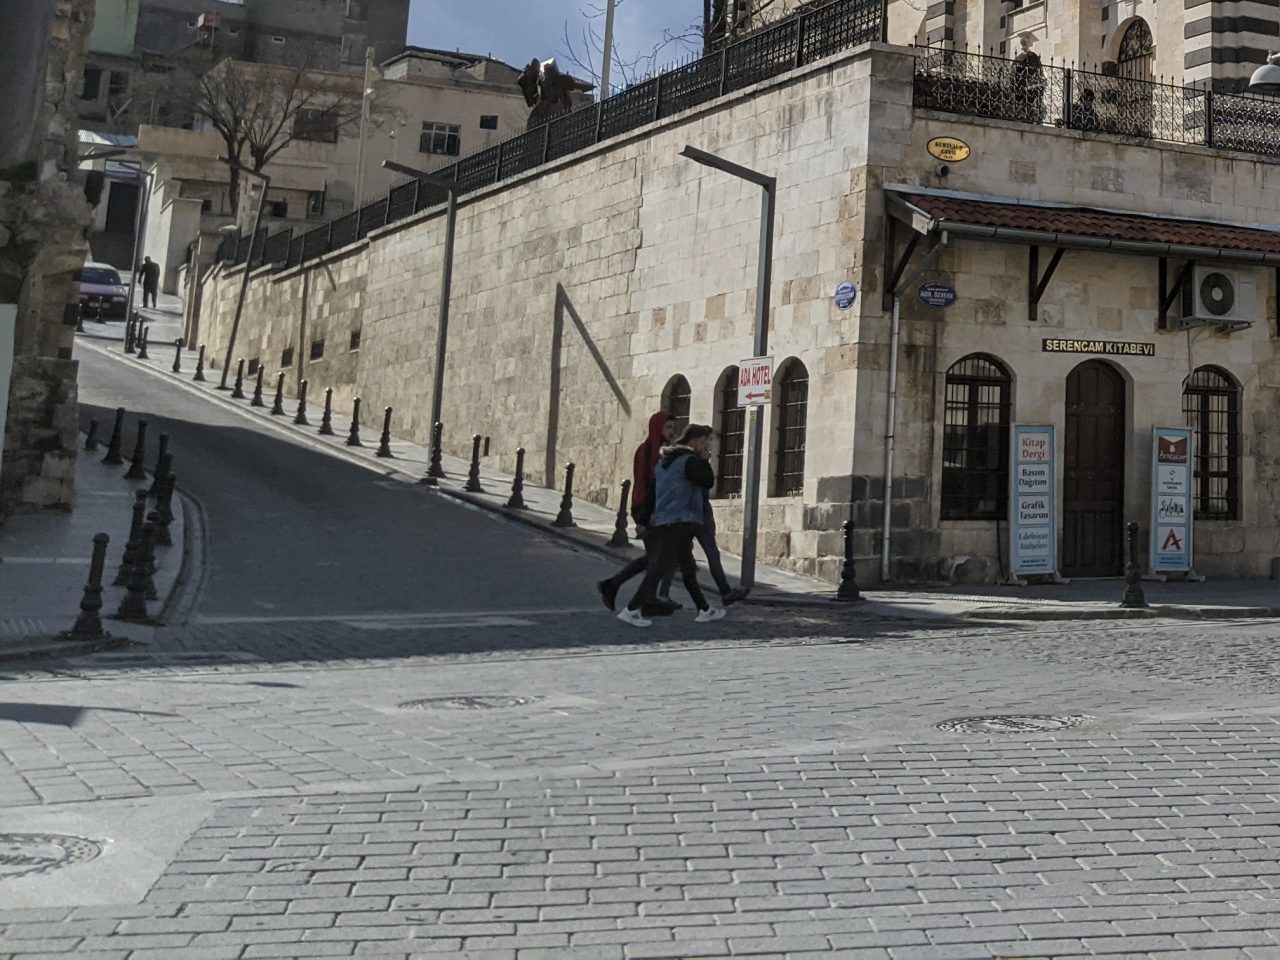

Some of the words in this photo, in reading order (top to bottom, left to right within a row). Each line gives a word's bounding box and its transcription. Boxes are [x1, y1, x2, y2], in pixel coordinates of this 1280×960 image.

[1045, 339, 1104, 353] SERENCAM
[1105, 342, 1153, 355] KİTABEVİ
[740, 367, 751, 387] ADA
[752, 364, 771, 386] HOTEL
[1022, 437, 1046, 449] Kitap
[1022, 449, 1046, 460] Dergi
[1022, 468, 1046, 477] Basım
[1018, 478, 1048, 488] Dağıtım
[1021, 500, 1046, 510] Grafik
[1019, 511, 1049, 520] Tasarım
